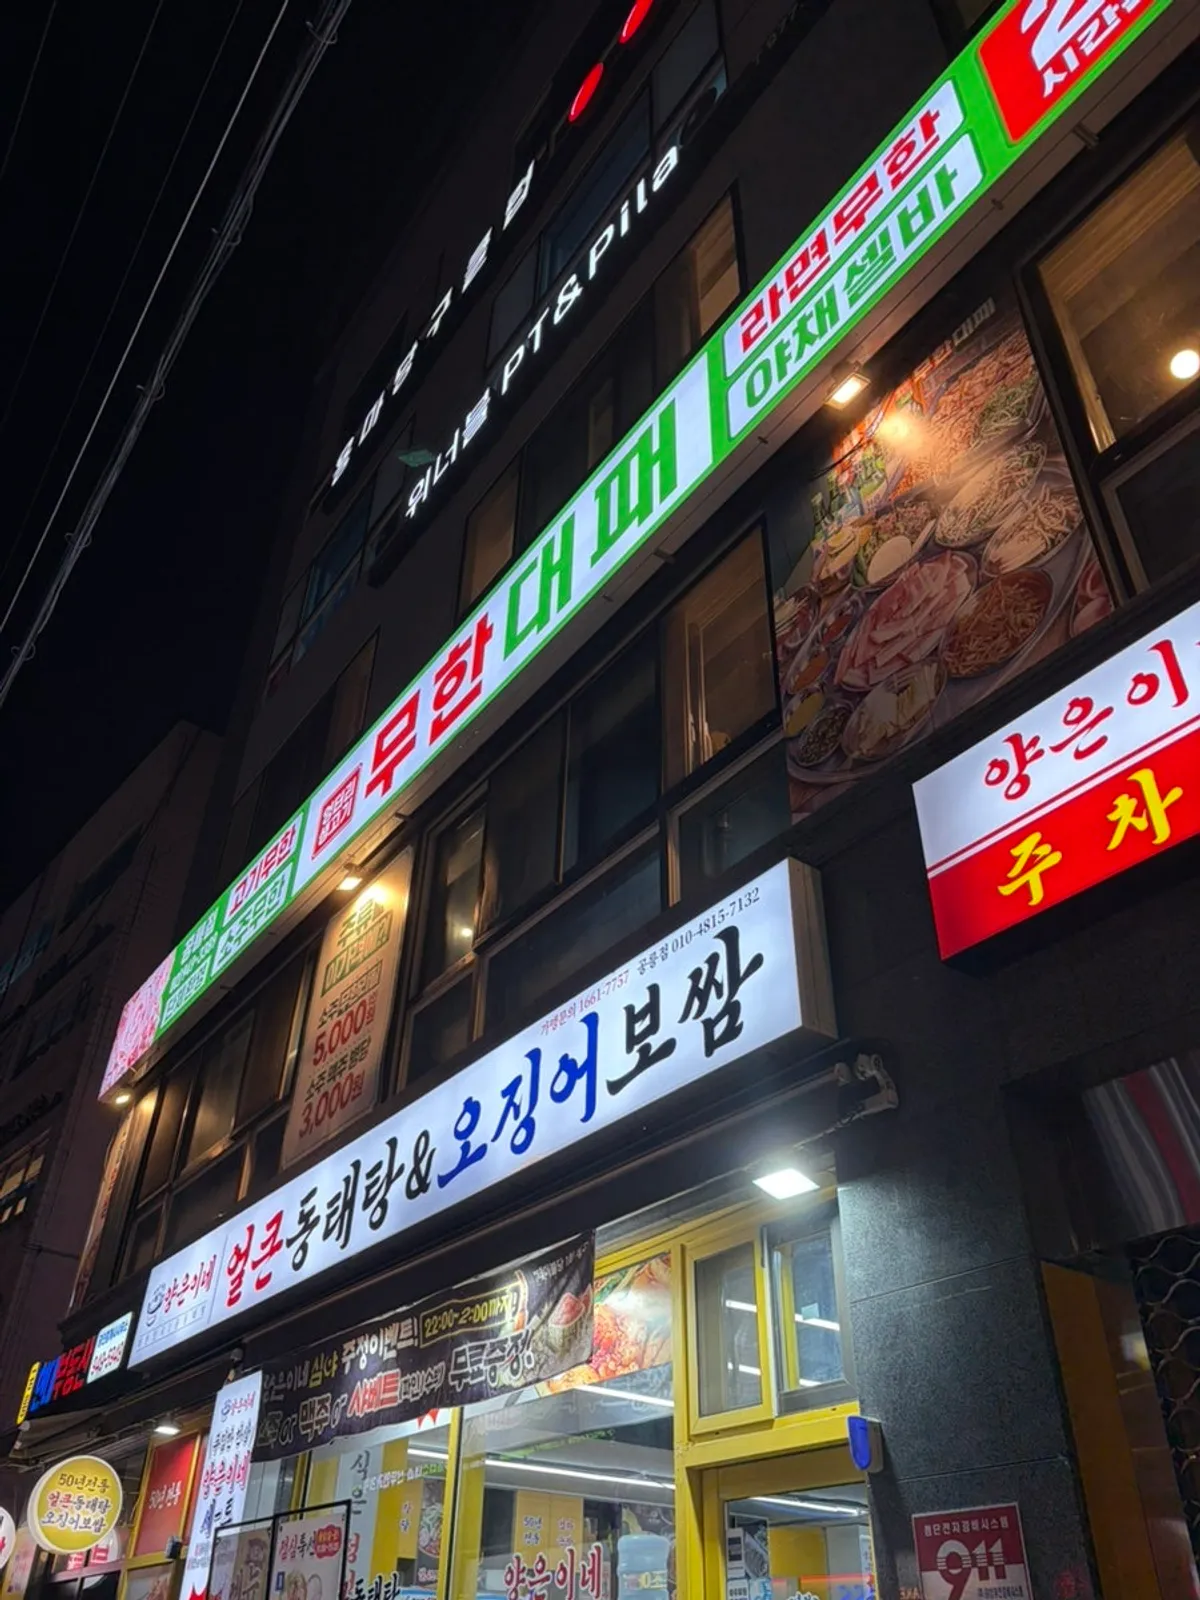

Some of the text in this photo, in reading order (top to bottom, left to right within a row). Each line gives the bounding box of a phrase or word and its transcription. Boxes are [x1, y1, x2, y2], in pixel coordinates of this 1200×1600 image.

[739, 107, 940, 353] 라면무한
[985, 638, 1200, 801] 양은이
[229, 823, 296, 917] 고기무한
[577, 969, 630, 1013] 1661-7757
[670, 886, 760, 954] 010-4815-7132
[41, 1511, 107, 1533] 오징어보쌈
[58, 1472, 111, 1495] 50년전통
[936, 1537, 1007, 1600] 911
